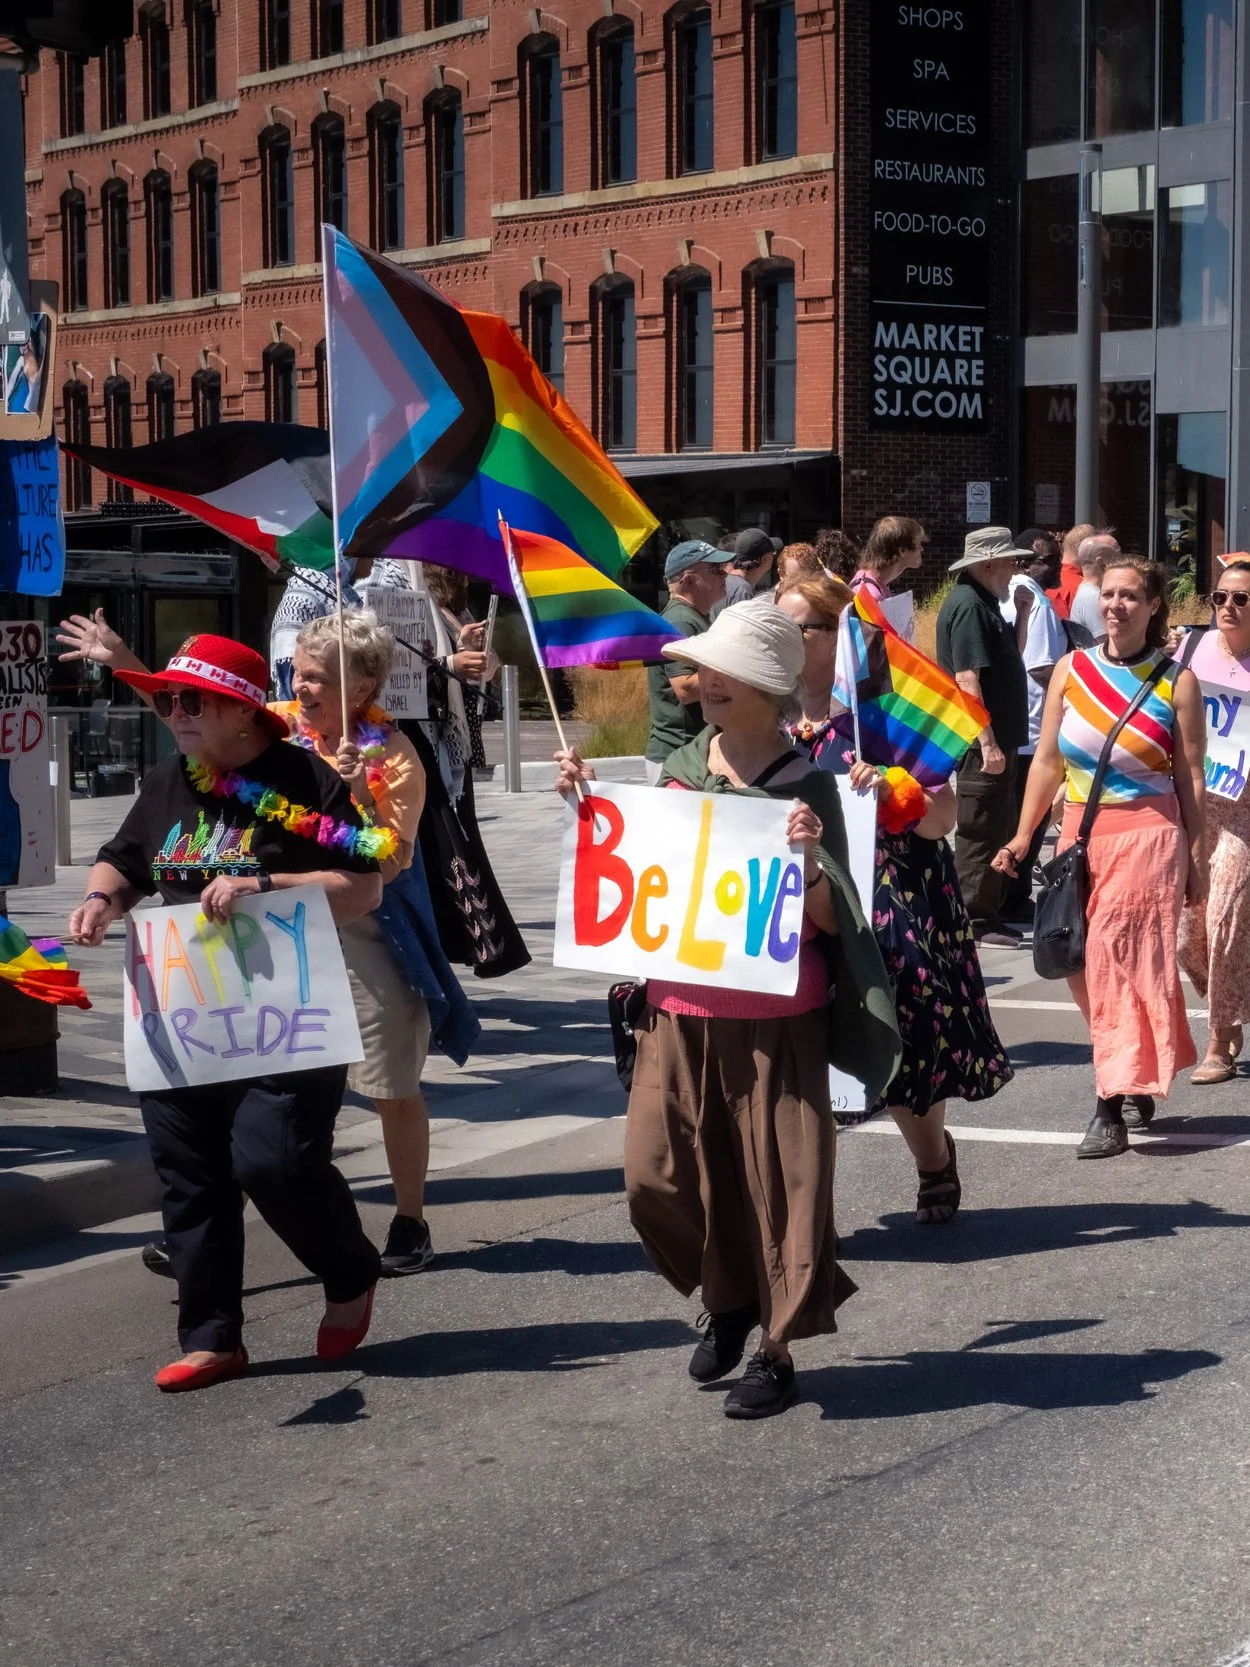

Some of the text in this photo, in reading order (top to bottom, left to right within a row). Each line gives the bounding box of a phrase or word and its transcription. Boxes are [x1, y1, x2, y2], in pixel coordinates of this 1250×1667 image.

[899, 5, 964, 31] SHOPS
[913, 58, 950, 81] SPA
[885, 108, 976, 134] SERVICES
[874, 159, 986, 187] RESTAURANTS
[874, 211, 986, 237] FOOD-TO-GO
[906, 265, 954, 287] PUBS
[874, 321, 984, 352] MARKET
[873, 354, 984, 386] SQUARE
[873, 388, 983, 419] SJ.COM
[20, 531, 54, 574] HAS
[389, 671, 422, 694] KILLED BY
[384, 692, 409, 712] ISRAEL
[153, 869, 188, 881] NEW
[573, 795, 669, 952] Be
[132, 901, 311, 1020] HAPPY
[140, 1005, 332, 1074] PRIDE
